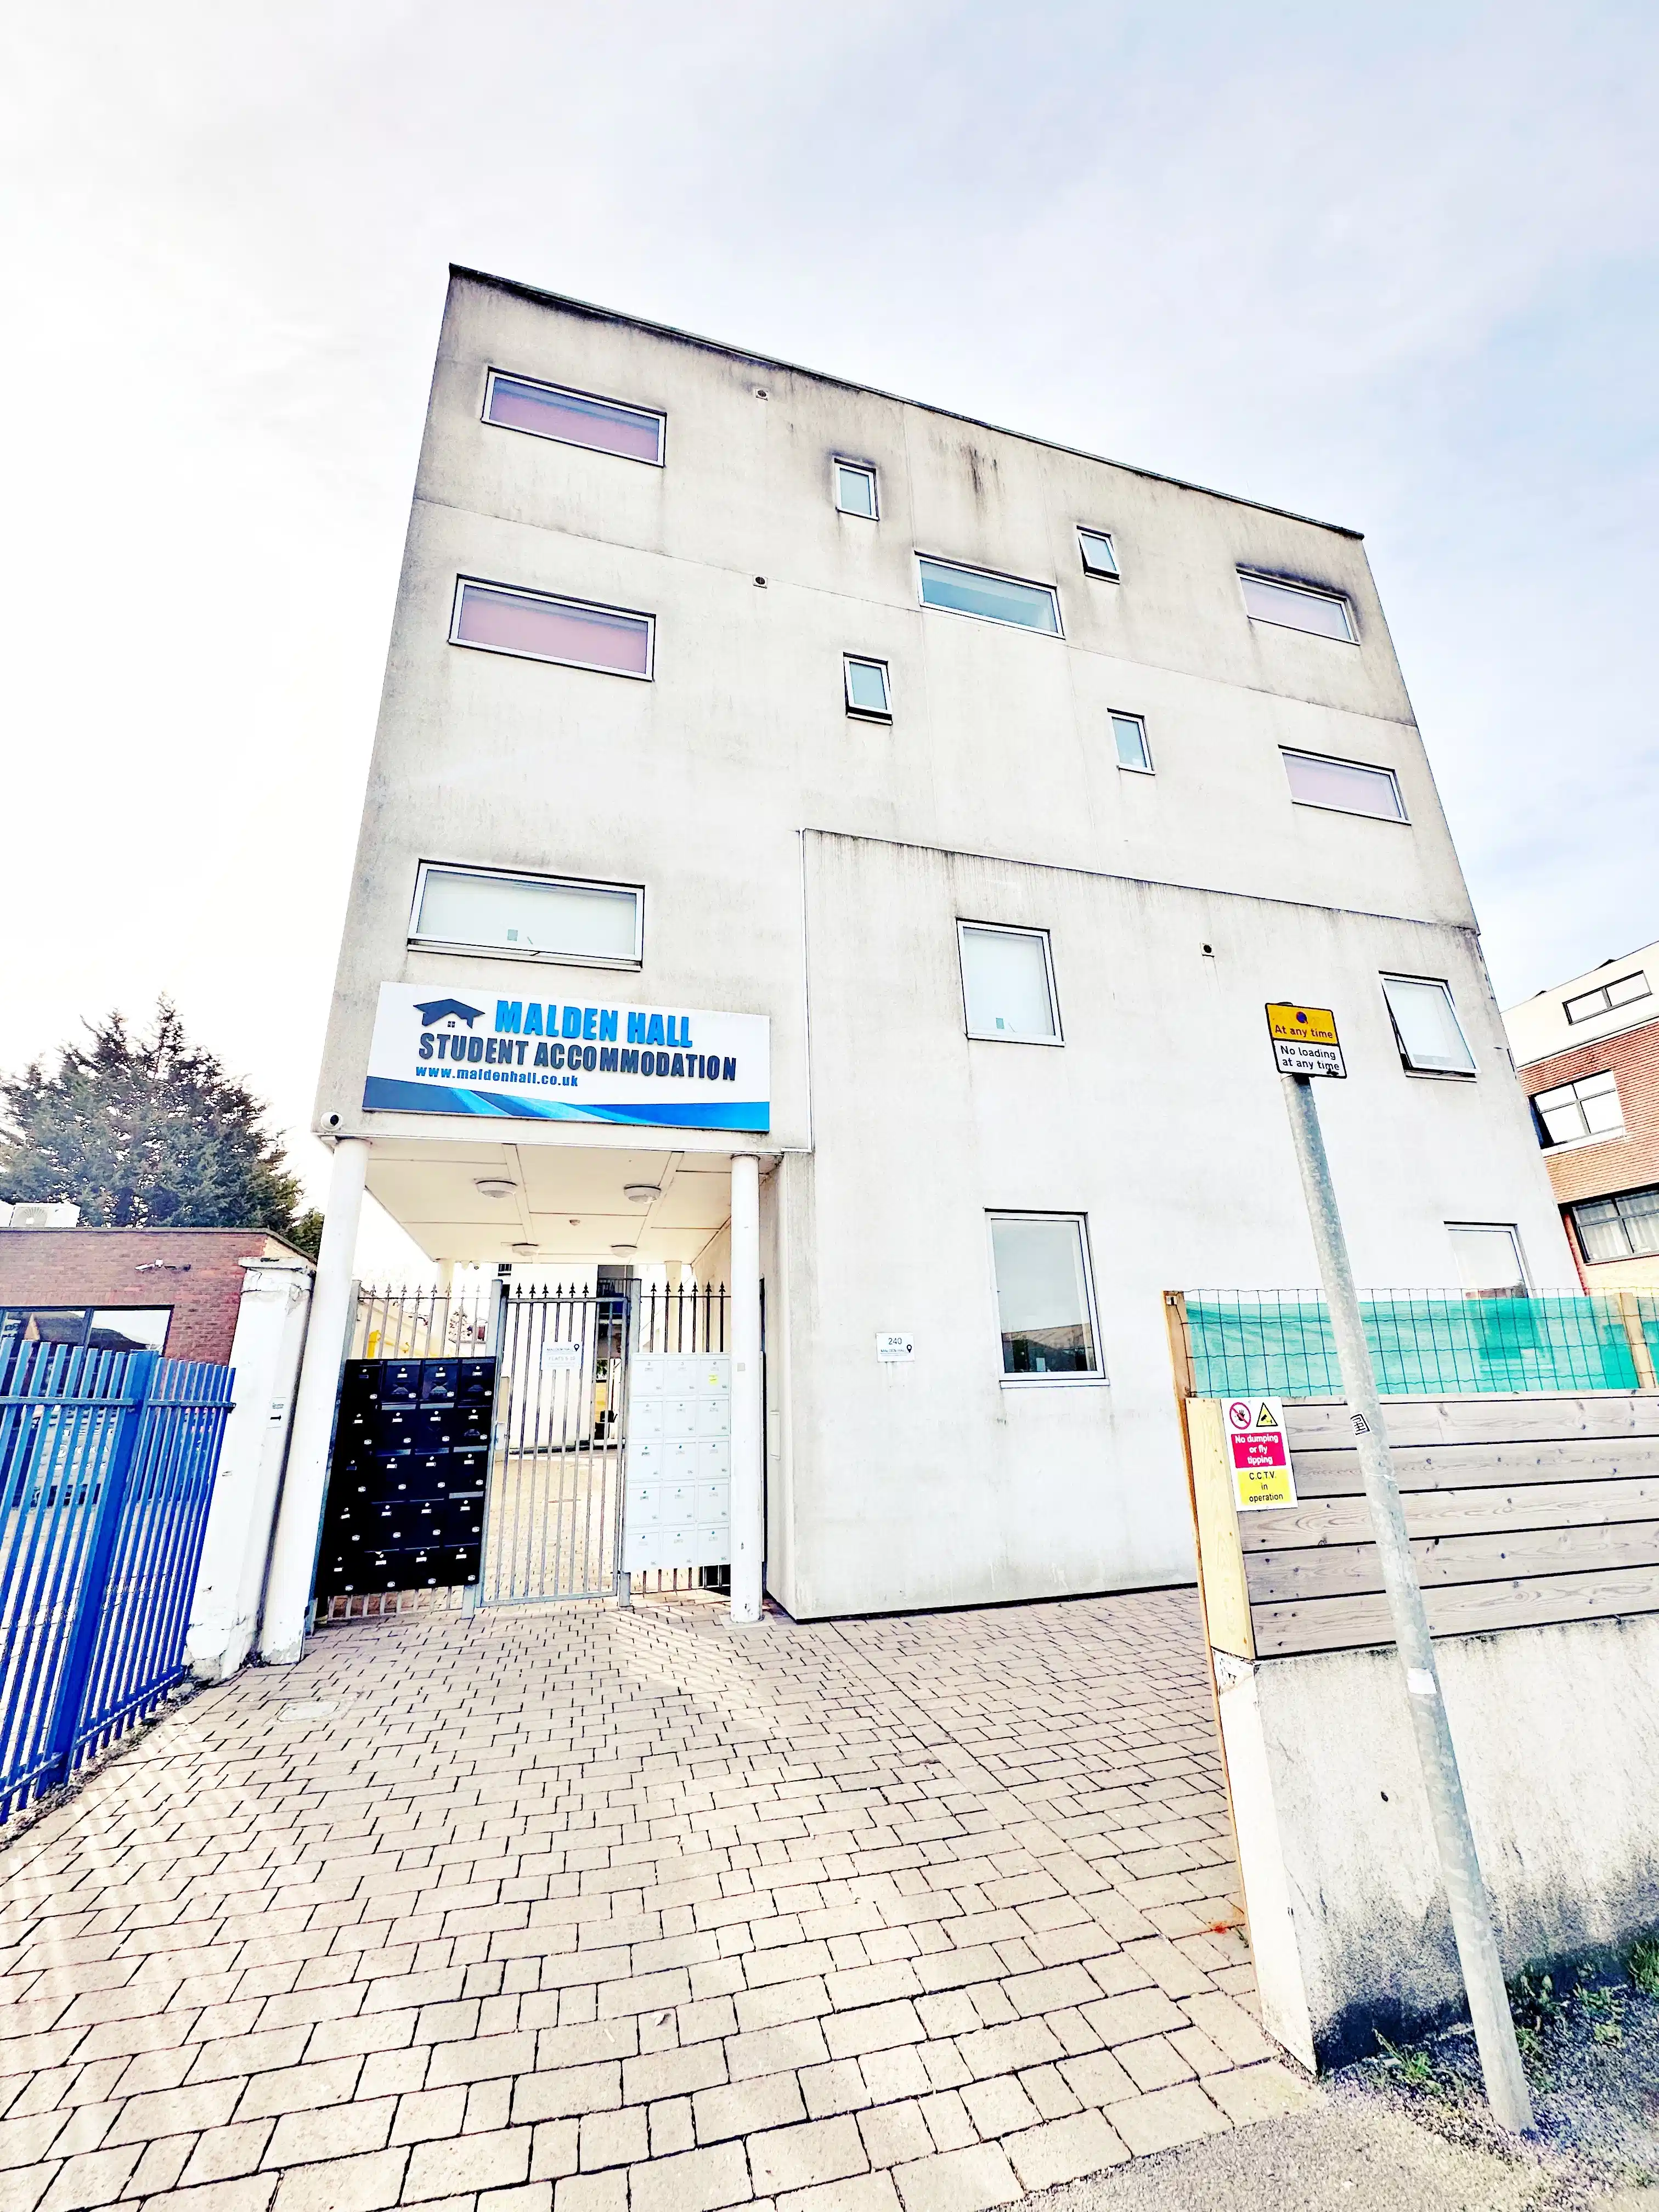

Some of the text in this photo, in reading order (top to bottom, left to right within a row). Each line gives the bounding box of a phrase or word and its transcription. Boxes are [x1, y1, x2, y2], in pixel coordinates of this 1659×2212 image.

[495, 1000, 693, 1048] MALDEN HALL
[1275, 1024, 1333, 1039] At any time
[419, 1032, 737, 1081] STUDENT ACCOMMODATION
[1280, 1045, 1336, 1060] No loading
[1282, 1058, 1340, 1070] at any time
[415, 1065, 578, 1087] www.maldenhall.co.uk
[1234, 1433, 1279, 1443] No dumping
[1258, 1444, 1268, 1455] fly
[1247, 1455, 1273, 1466] tipping
[1249, 1493, 1283, 1503] operation
